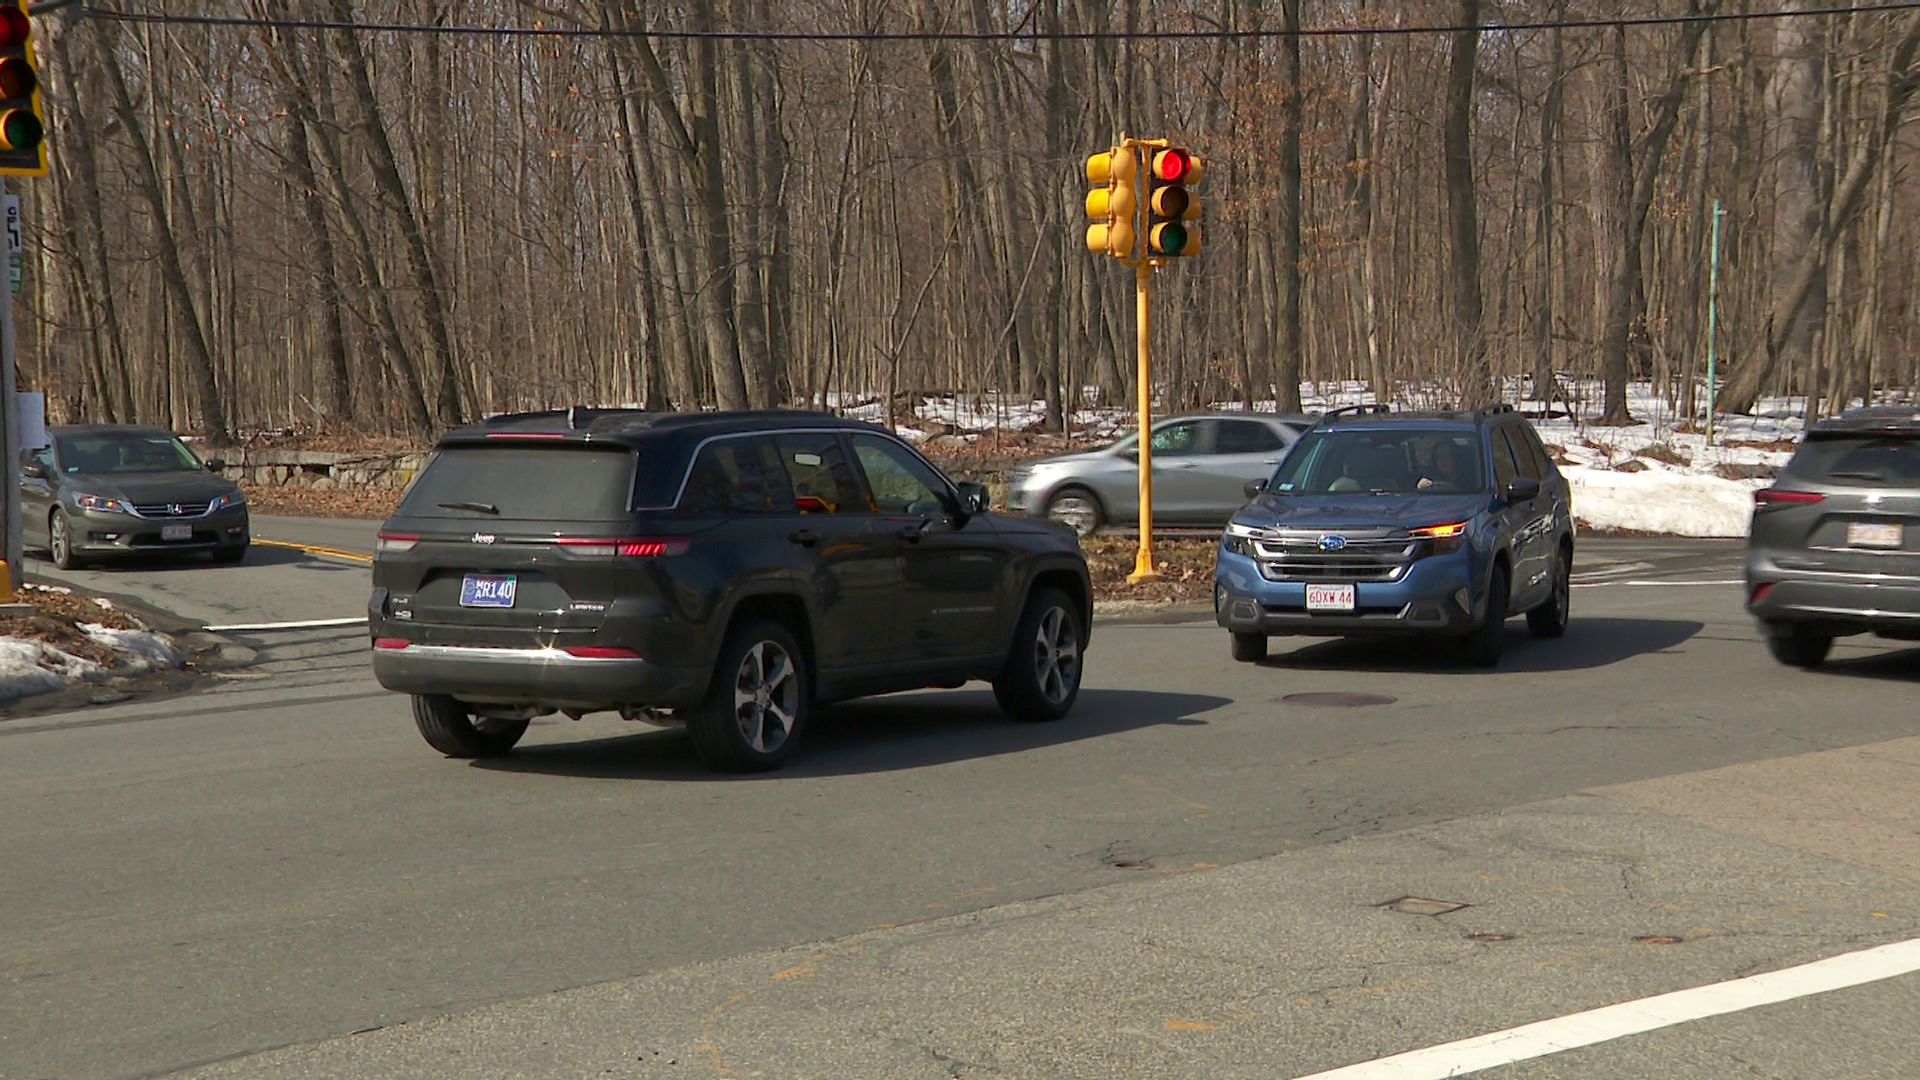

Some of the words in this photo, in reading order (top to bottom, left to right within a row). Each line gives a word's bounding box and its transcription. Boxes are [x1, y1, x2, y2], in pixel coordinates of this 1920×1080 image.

[472, 532, 495, 545] Jeep
[1309, 591, 1335, 603] 6DXW
[1339, 591, 1352, 603] 44
